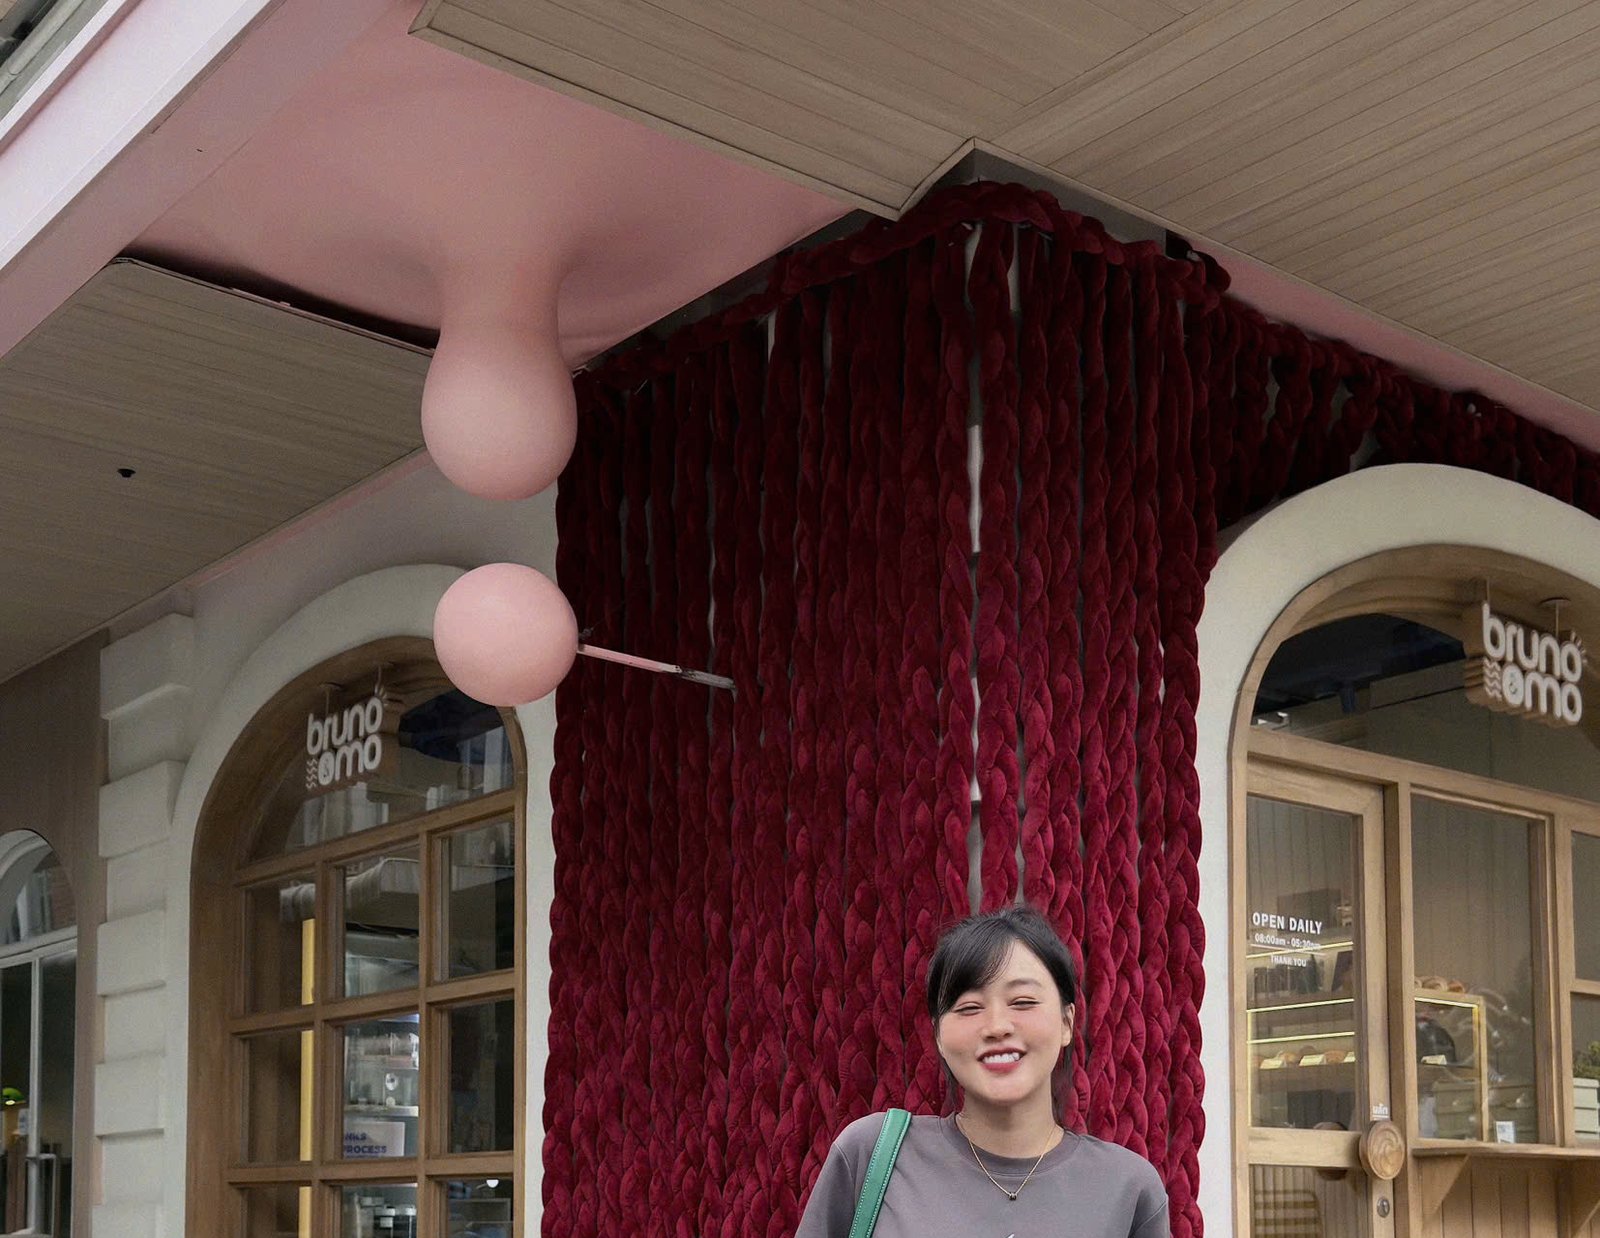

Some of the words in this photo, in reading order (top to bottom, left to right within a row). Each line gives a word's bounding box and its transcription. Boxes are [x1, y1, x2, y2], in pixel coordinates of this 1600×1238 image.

[1482, 602, 1582, 683] bruno
[306, 697, 383, 755] bruno
[1252, 912, 1285, 930] OPEN
[1289, 917, 1323, 935] DAILY
[1254, 933, 1286, 946] 08:00am
[1270, 955, 1292, 965] THANK
[1293, 958, 1307, 967] YOU
